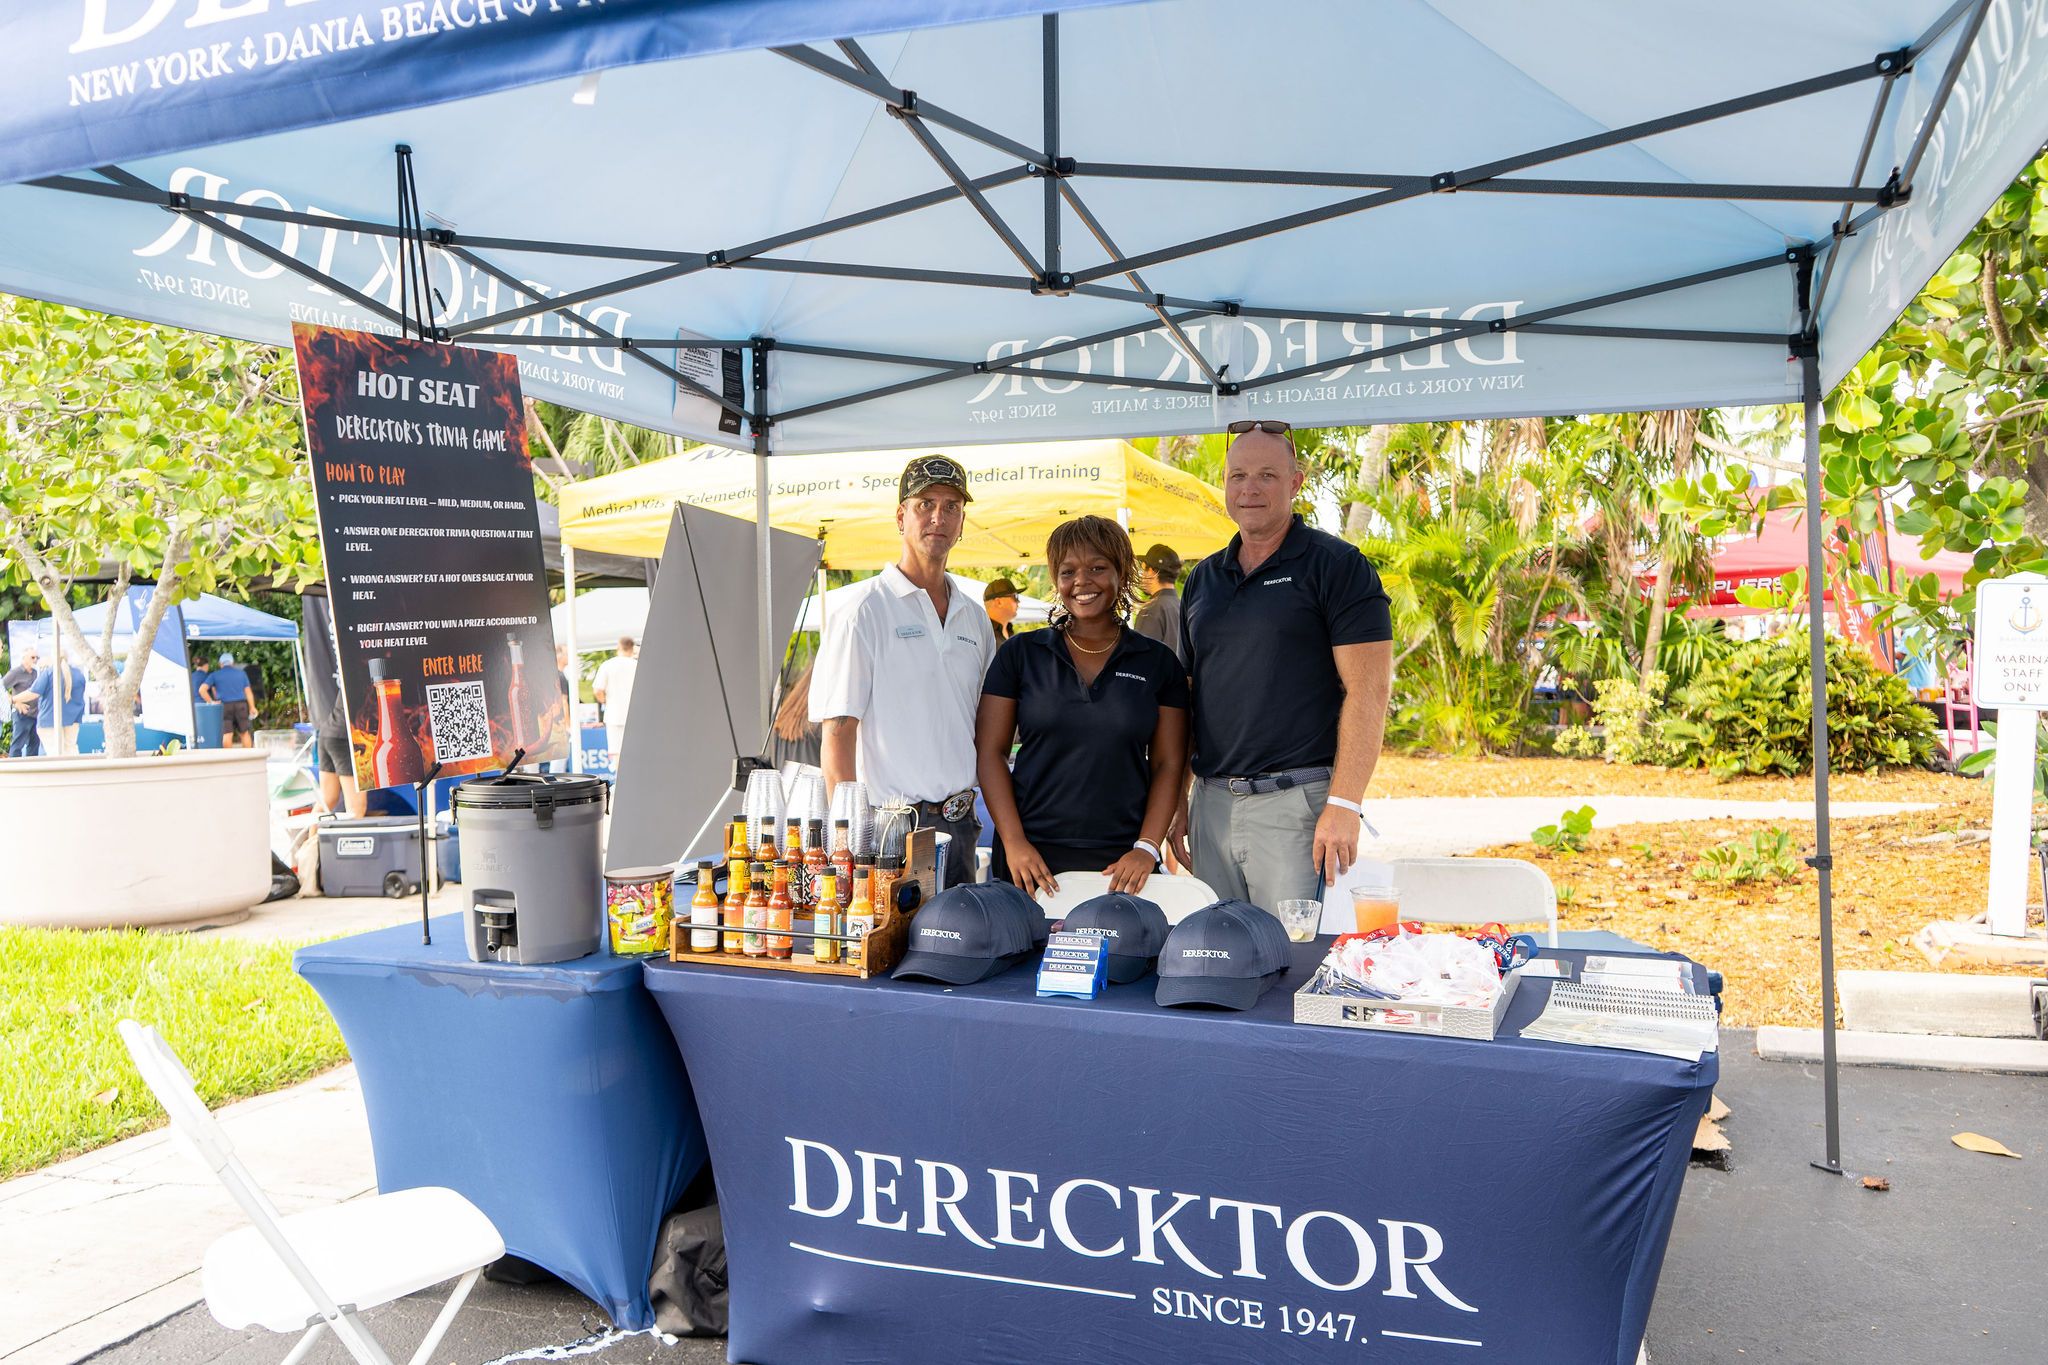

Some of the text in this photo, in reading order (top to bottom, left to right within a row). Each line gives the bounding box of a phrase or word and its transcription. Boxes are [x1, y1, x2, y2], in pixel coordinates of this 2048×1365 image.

[67, 61, 141, 107] NEW
[144, 41, 235, 90] YORK
[263, 16, 375, 66] DANIA
[380, 0, 509, 42] BEACH
[357, 370, 481, 409] HOT SEAT
[335, 414, 507, 452] DERECKTOR'S TRIVIA GAME
[325, 461, 406, 487] HOW TO PLAY
[1029, 465, 1101, 482] Training
[338, 493, 526, 510] PICK YOUR HEAT LEVEL MILD, MEDIUM, OR HARD.
[582, 500, 638, 519] Medical
[685, 487, 772, 505] Telemedicl
[777, 478, 841, 496] Support
[343, 526, 534, 539] ANSWER ONE DERECKTOR TRIVIA QUESTION AT THAT
[345, 542, 373, 552] LEVEL.
[350, 573, 534, 584] WRONG ANSWER? EAT A HOT ONES SAUCE AT YOUR
[1263, 576, 1292, 586] DERECKTOR
[352, 591, 377, 601] HEAT.
[357, 616, 538, 633] RIGHT ANSWER? YOU WIN A PRIZE ACCORDING TO
[359, 636, 428, 649] YOUR HEAT LEVEL
[422, 653, 484, 677] ENTER HERE
[1115, 671, 1147, 682] DERECKTOR
[2003, 668, 2044, 678] STAFF
[2004, 682, 2041, 692] ONLY
[920, 927, 962, 941] DERECKTOR
[1075, 927, 1120, 938] DERECKTOR
[1055, 936, 1093, 945] DERECKTOR
[1051, 950, 1090, 959] DERECKTOR
[1182, 949, 1231, 960] DERECKTOR
[1048, 963, 1087, 973] DERECKTOR
[785, 1135, 1479, 1313] DERECKTOR
[1152, 1286, 1368, 1345] SINCE 1947.
